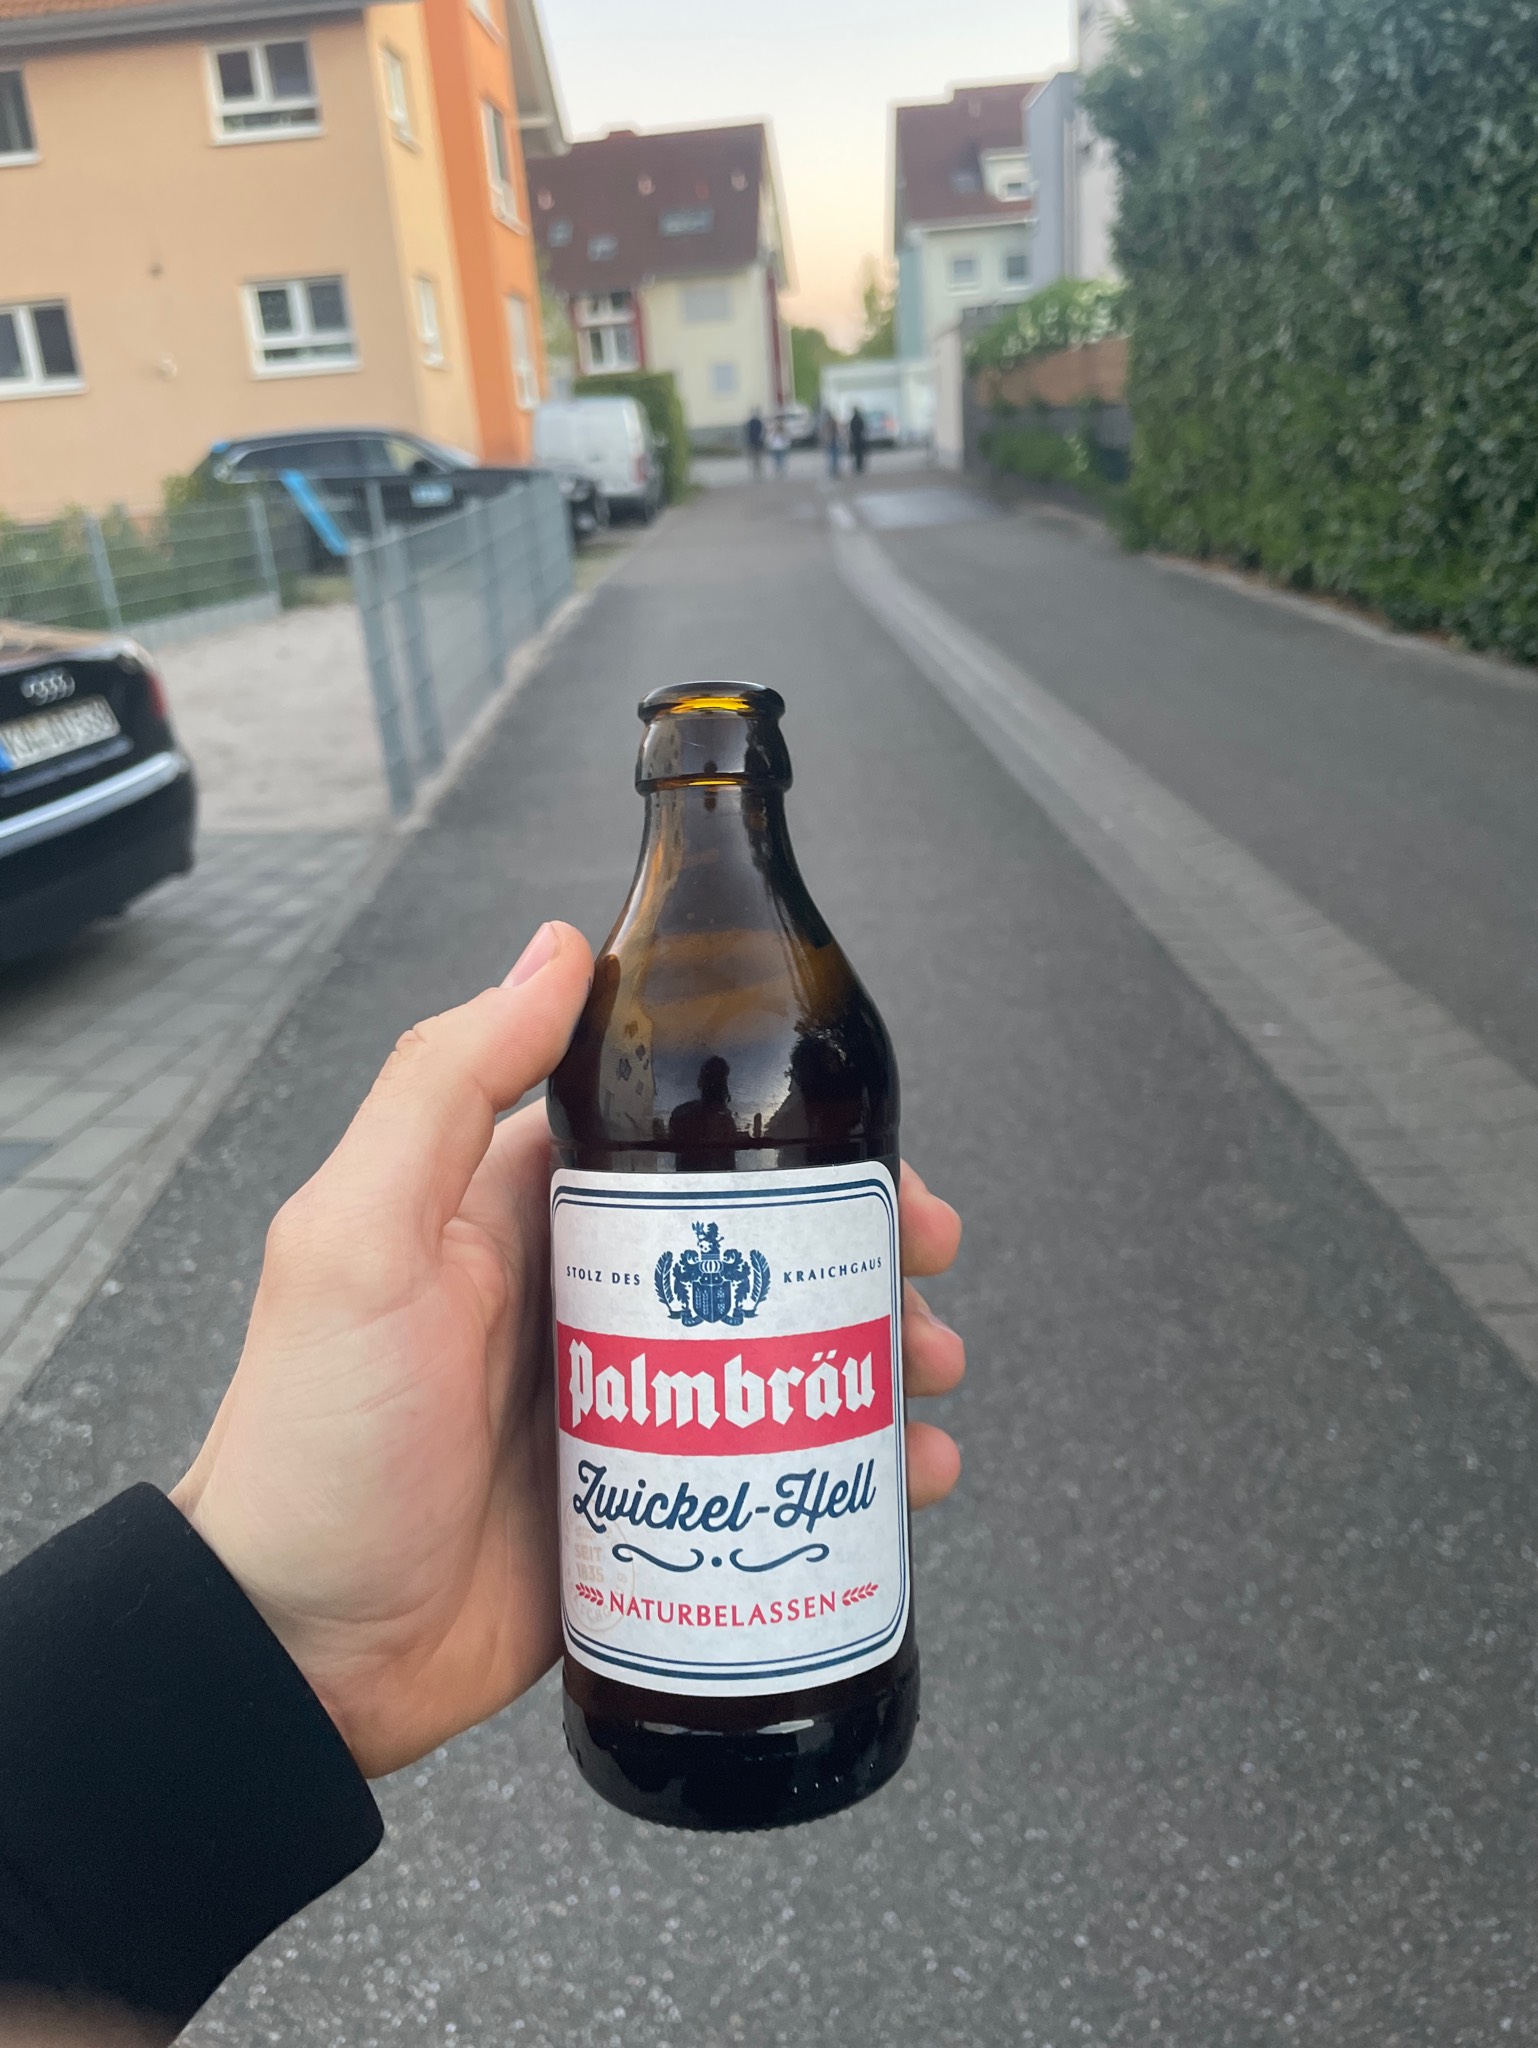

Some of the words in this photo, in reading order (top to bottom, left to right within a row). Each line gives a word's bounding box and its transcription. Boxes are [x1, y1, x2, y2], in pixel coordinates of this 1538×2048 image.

[566, 1265, 602, 1283] STOLZ
[611, 1272, 641, 1286] DES
[783, 1256, 883, 1284] KRAICHGAUS
[569, 1338, 876, 1430] Palmbräu
[572, 1458, 877, 1534] Zwickel-Hell
[609, 1590, 837, 1627] NATURBELASSEN
